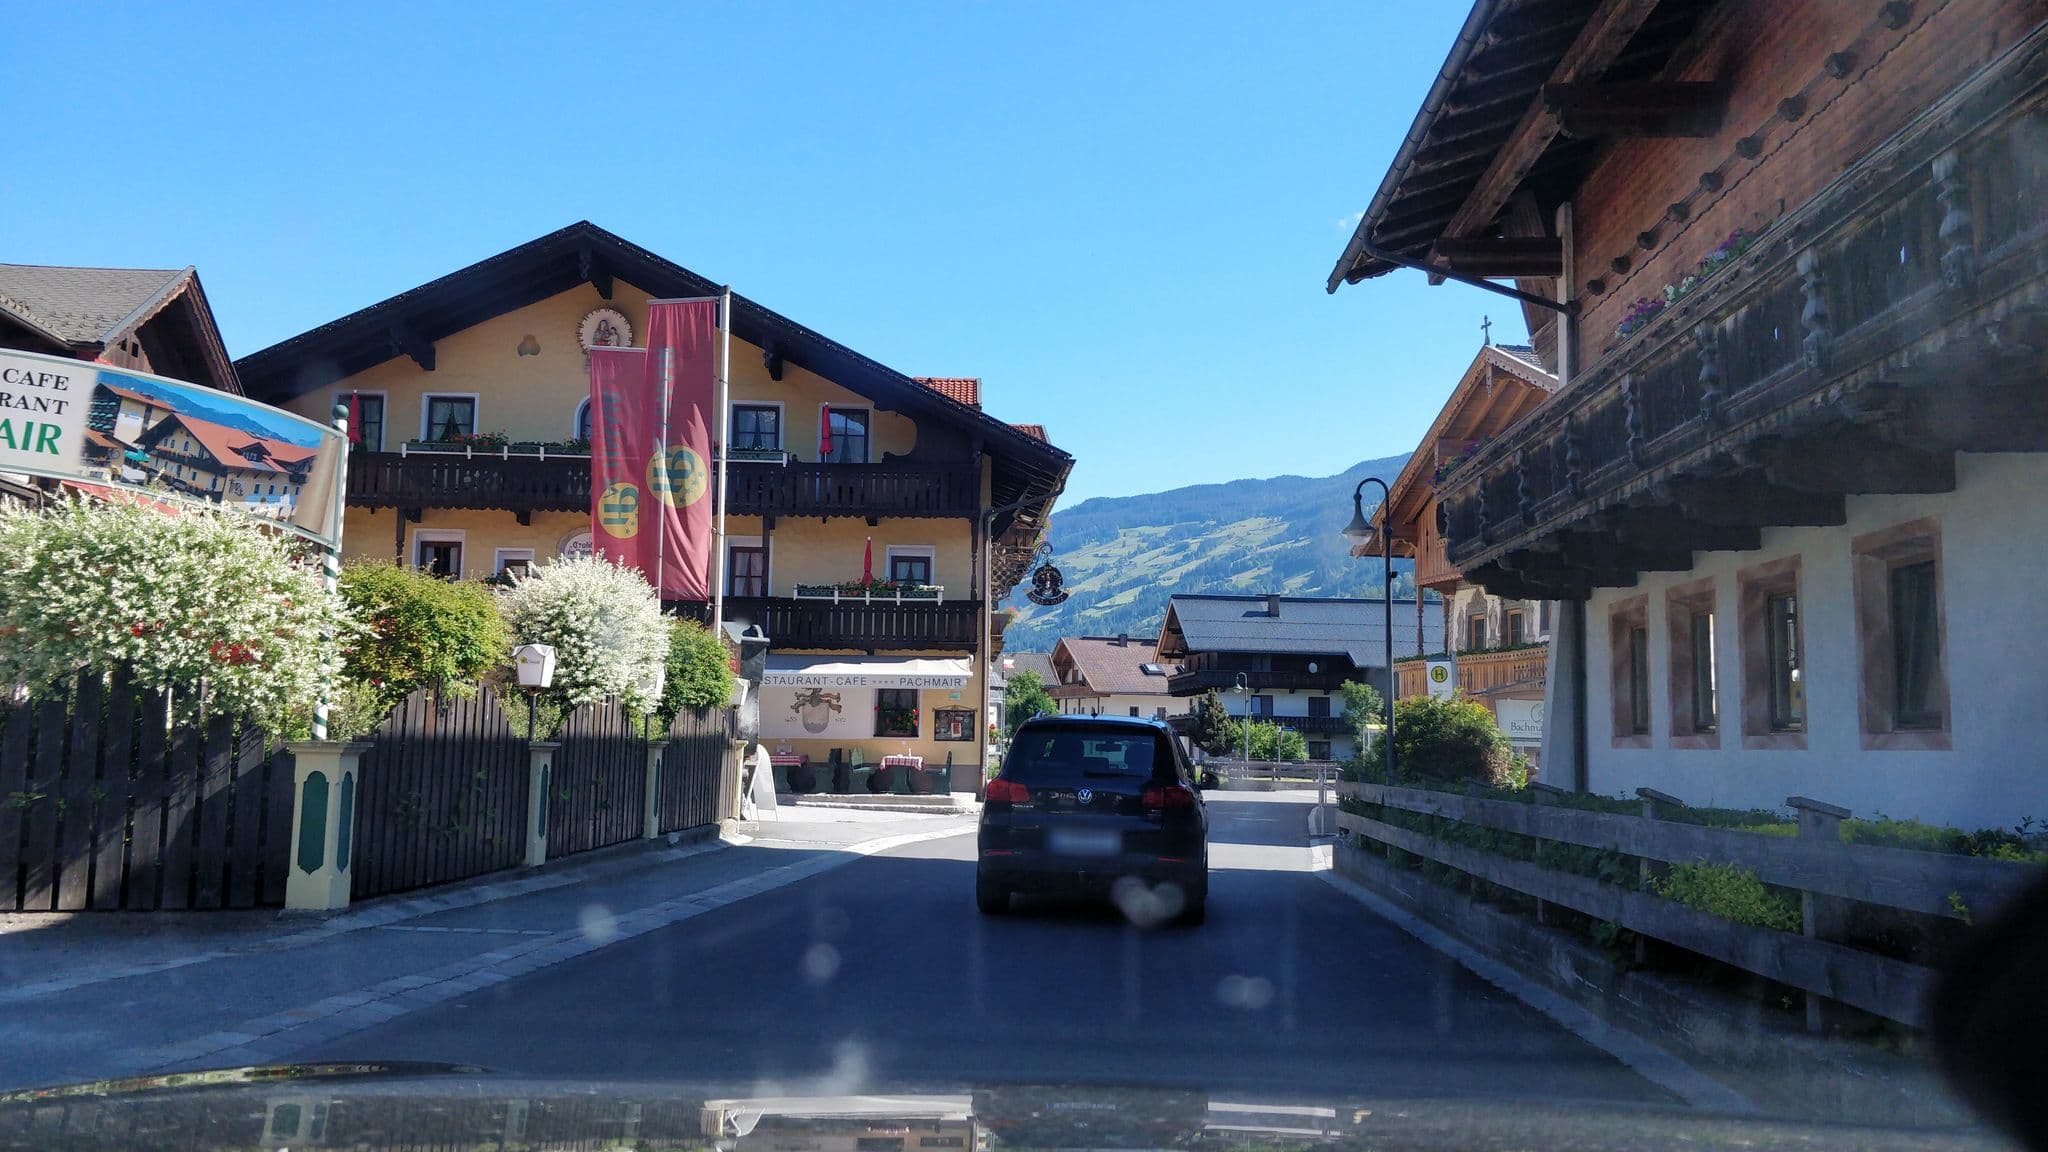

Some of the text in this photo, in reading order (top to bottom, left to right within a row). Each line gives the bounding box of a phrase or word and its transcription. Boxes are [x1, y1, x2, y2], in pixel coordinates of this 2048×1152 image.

[3, 368, 70, 391] CAFE
[0, 391, 69, 415] RANT
[0, 418, 62, 455] AIR
[899, 677, 962, 687] PACHMAIR
